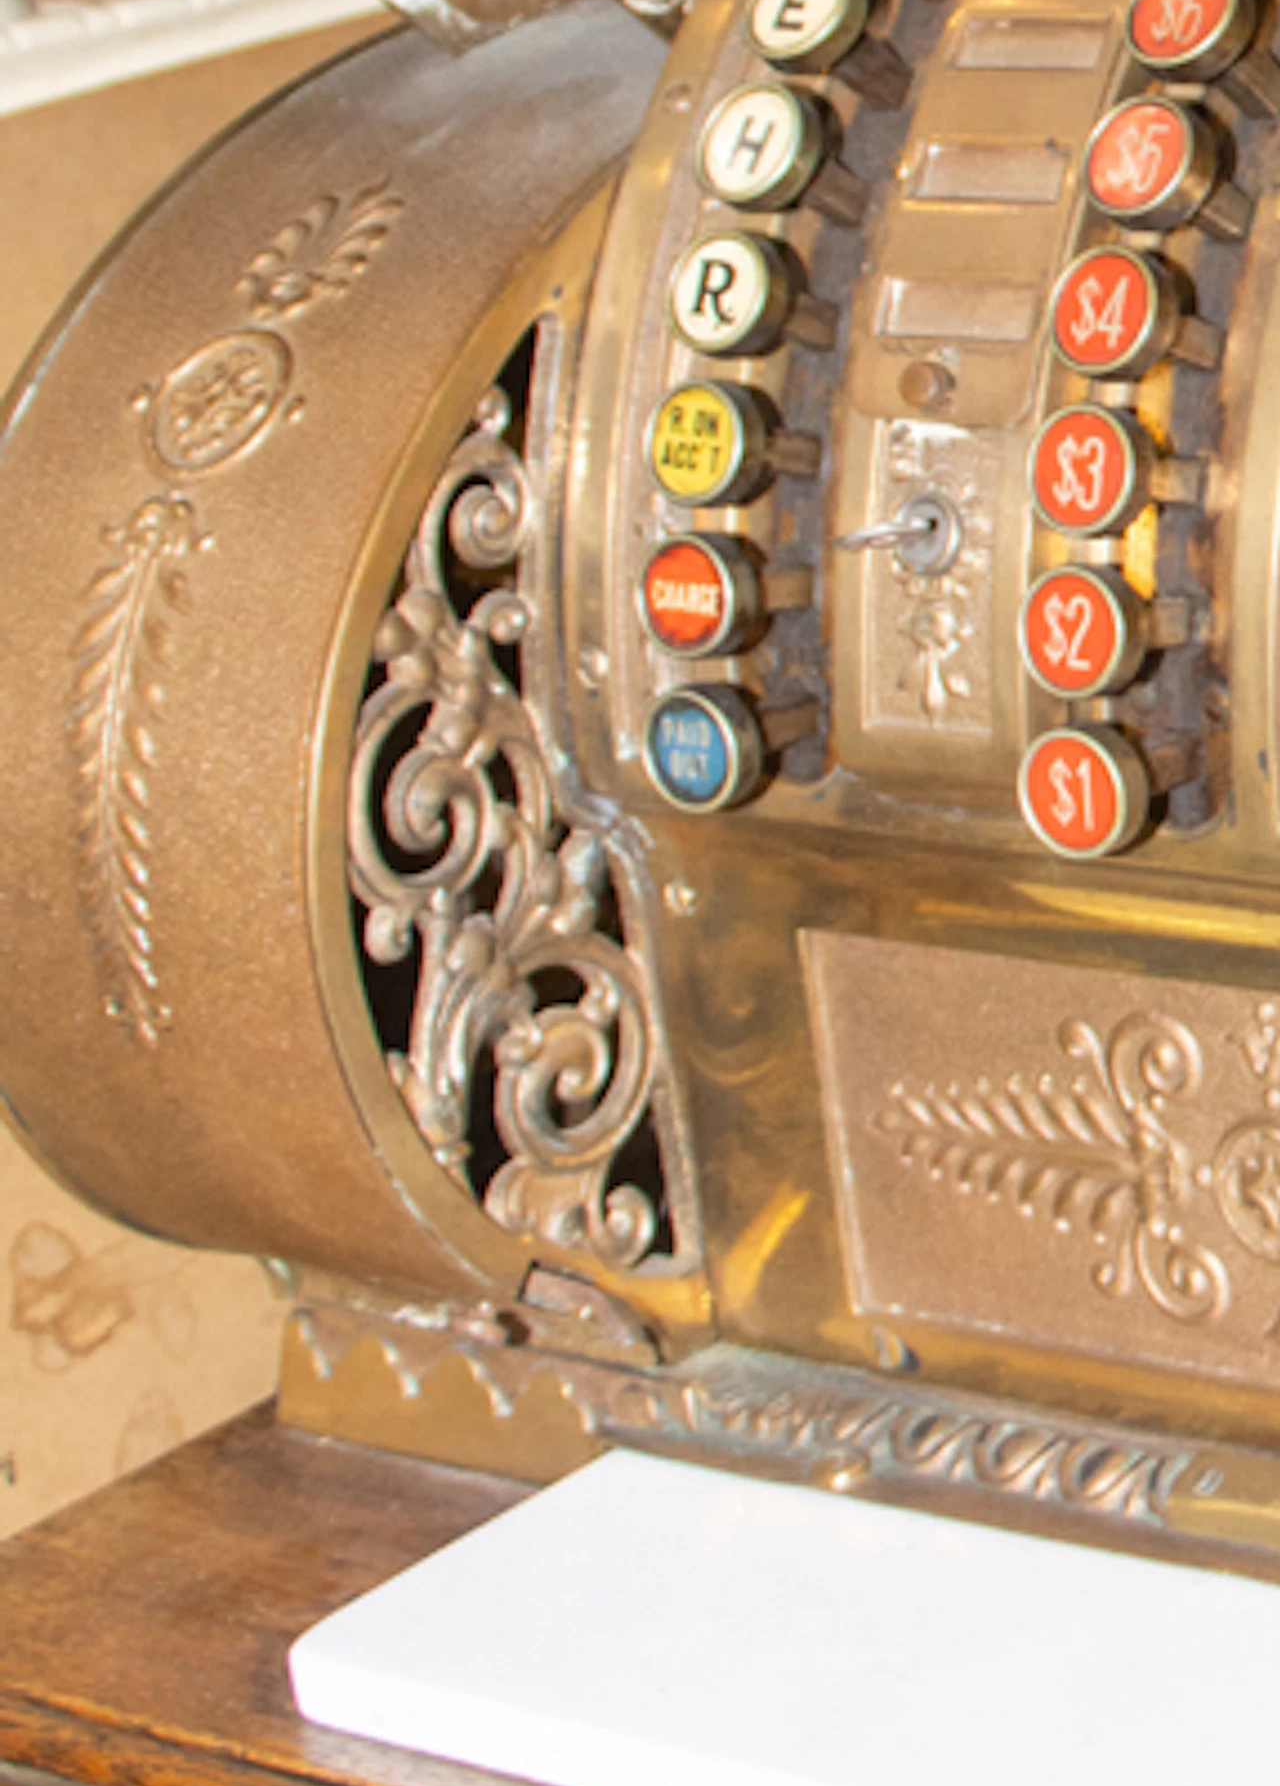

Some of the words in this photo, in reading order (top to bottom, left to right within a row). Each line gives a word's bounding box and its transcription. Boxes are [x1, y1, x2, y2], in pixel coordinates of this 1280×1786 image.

[728, 115, 775, 175] H
[1105, 121, 1170, 193] $5
[690, 258, 735, 328] R
[1070, 275, 1131, 349] $4
[1053, 434, 1107, 511] $3
[651, 578, 722, 618] CHARGE
[1042, 593, 1092, 672] $2
[660, 715, 713, 747] PAID
[668, 752, 710, 787] OUT
[1048, 757, 1095, 832] $1
